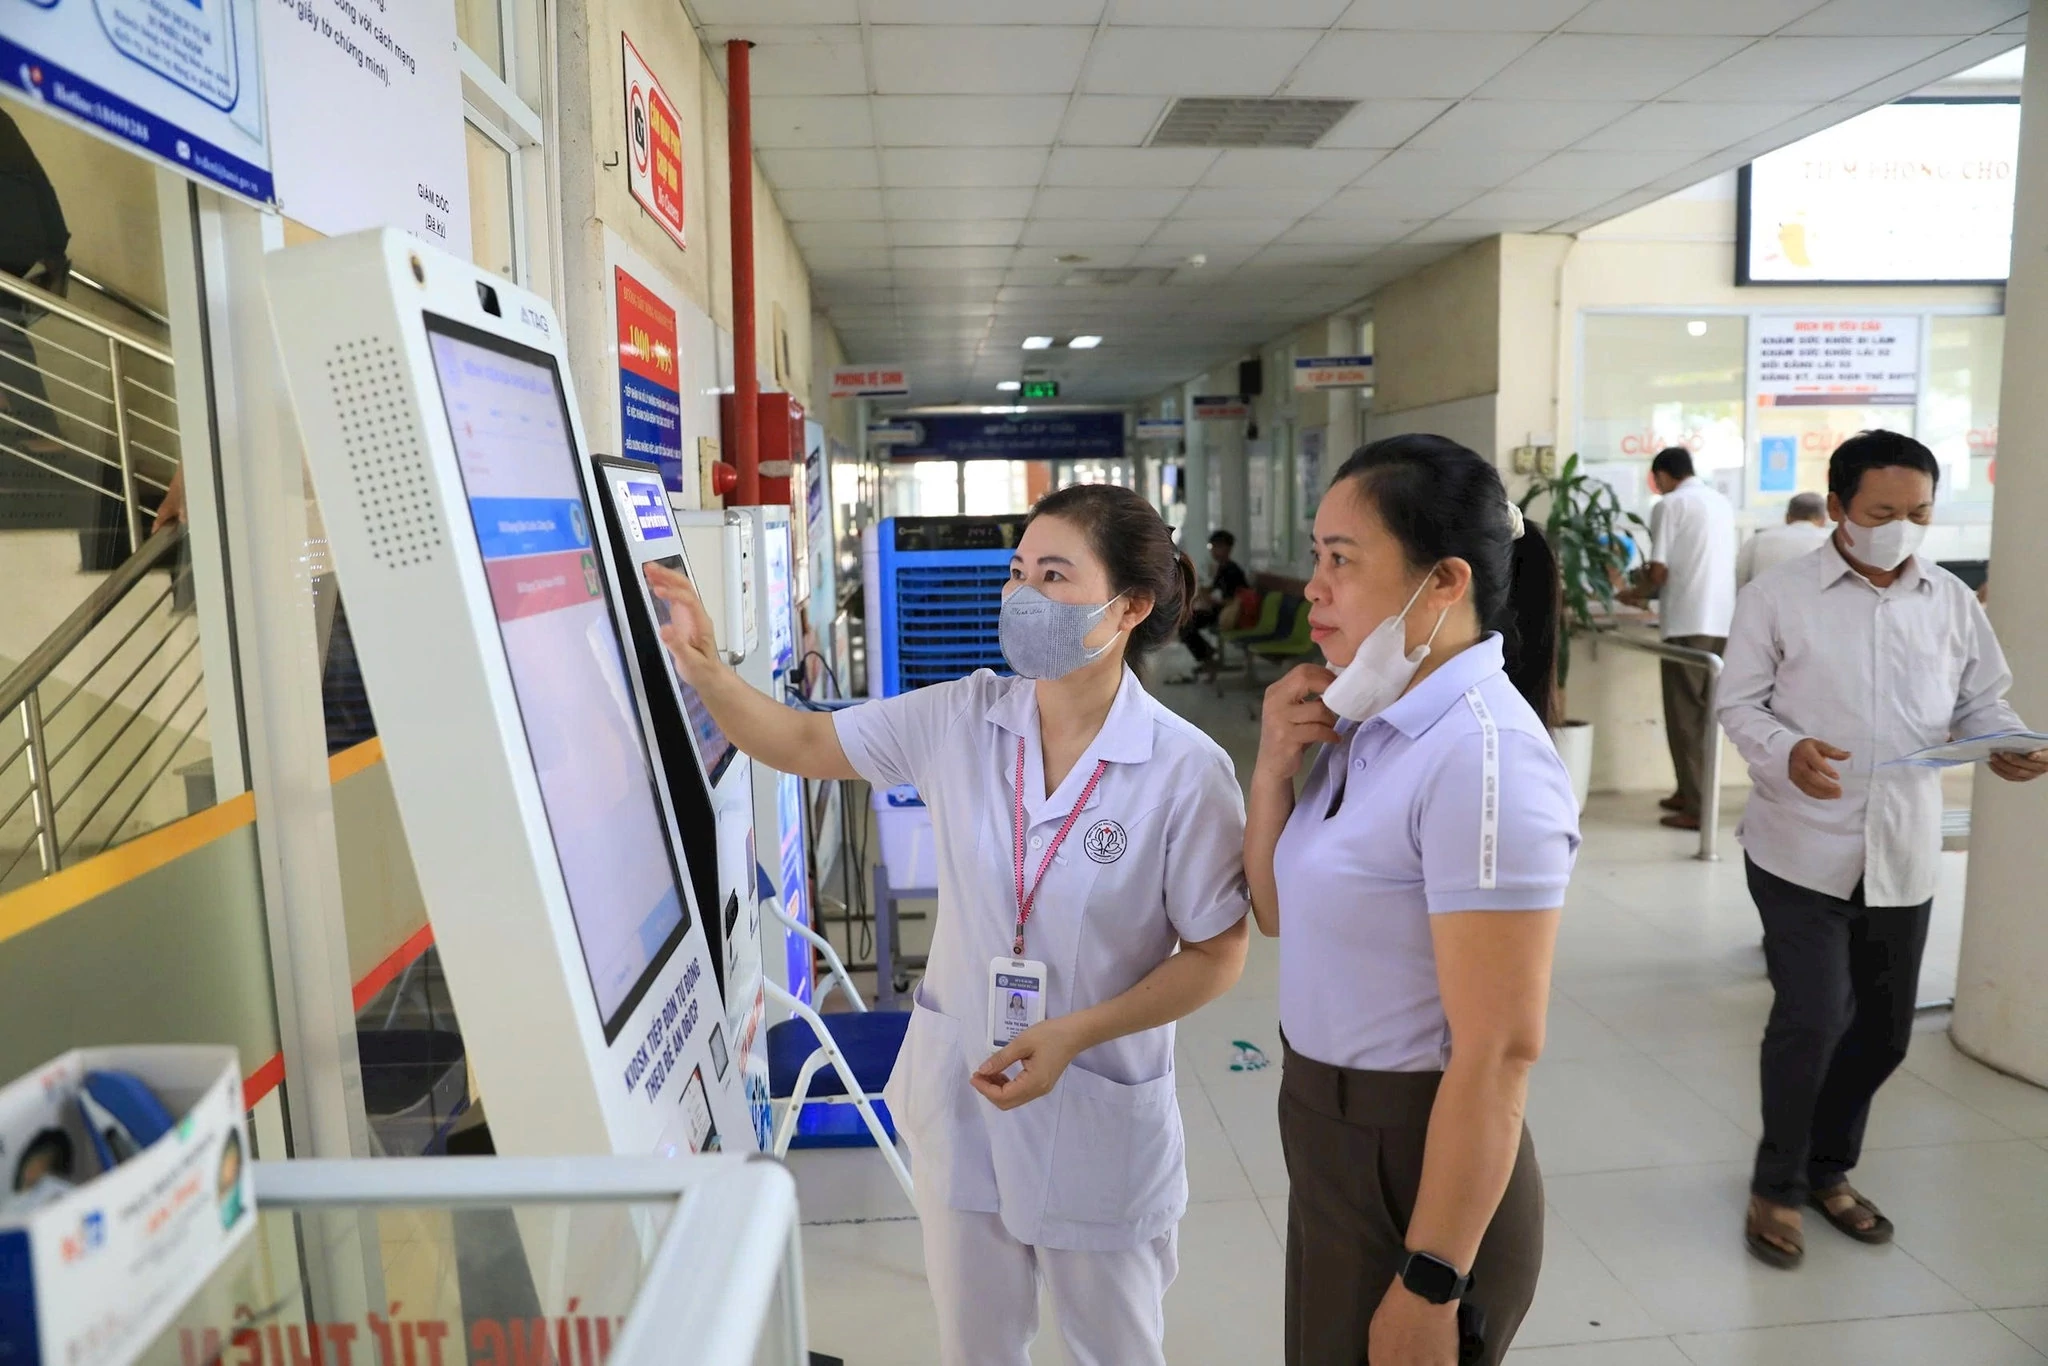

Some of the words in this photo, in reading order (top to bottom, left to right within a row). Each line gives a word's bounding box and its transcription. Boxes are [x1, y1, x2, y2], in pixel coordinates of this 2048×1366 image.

[297, 1, 319, 32] giấy
[334, 28, 364, 68] chứng
[359, 11, 373, 35] với
[374, 25, 393, 52] cách
[394, 45, 416, 75] mạng
[417, 183, 435, 205] GIÁM
[435, 194, 450, 214] ĐỐC
[629, 324, 650, 363] 1900
[624, 1040, 650, 1094] KIOSK
[647, 1014, 663, 1054] TIẾP
[662, 995, 679, 1031] ĐÓN
[675, 977, 687, 1007] TỰ
[683, 957, 701, 992] ĐỘNG
[645, 1060, 665, 1104] THEO
[662, 1035, 675, 1073] ĐỀ
[672, 1026, 684, 1057] ÁN
[681, 998, 699, 1039] 06/CP
